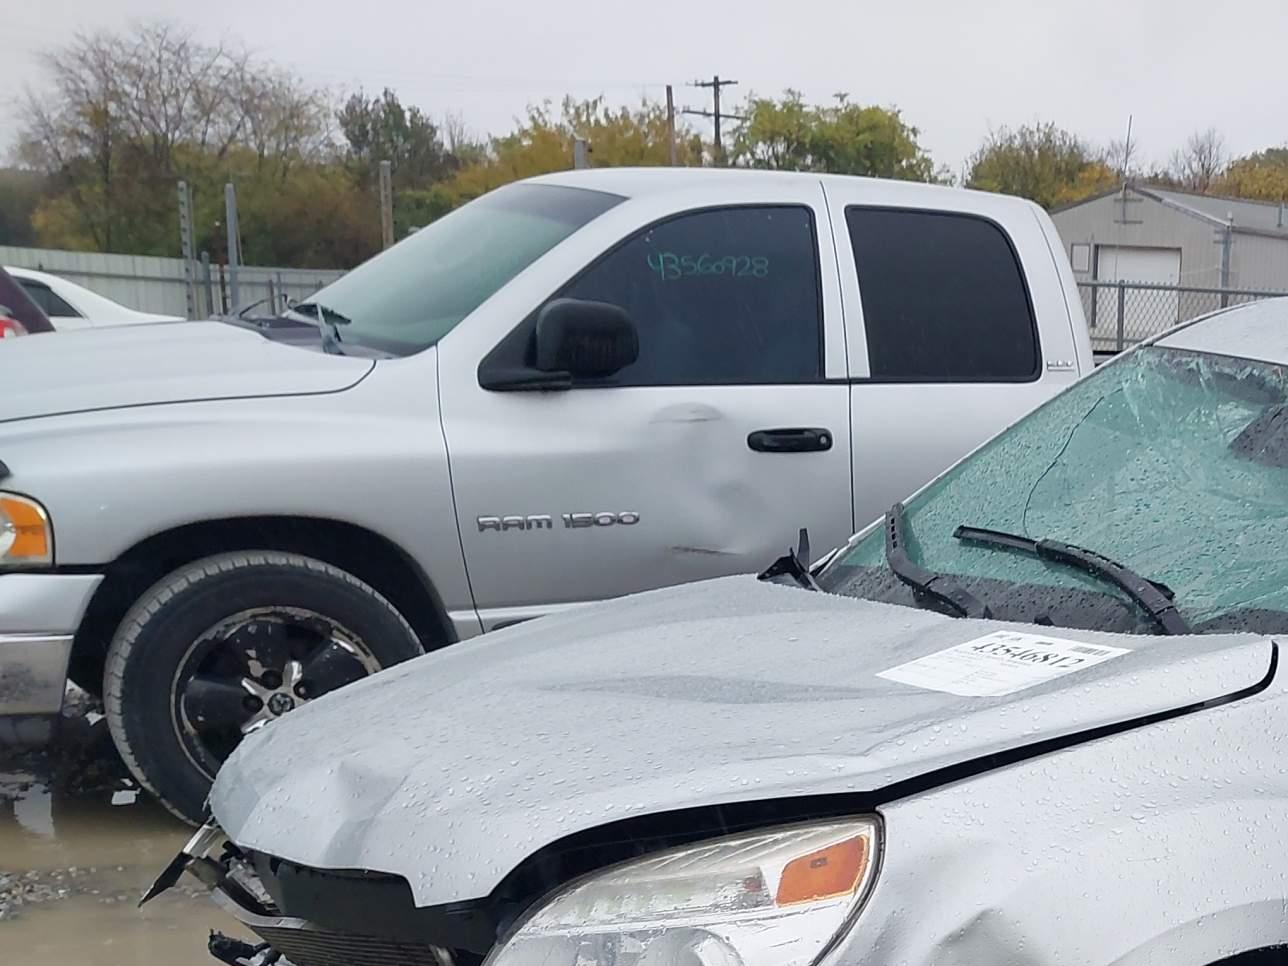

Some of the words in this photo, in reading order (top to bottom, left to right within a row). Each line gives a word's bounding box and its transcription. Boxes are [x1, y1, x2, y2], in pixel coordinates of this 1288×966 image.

[646, 252, 769, 281] 43560928
[477, 514, 553, 533] RAM
[562, 511, 640, 529] 1500
[972, 642, 1085, 668] 43546812
